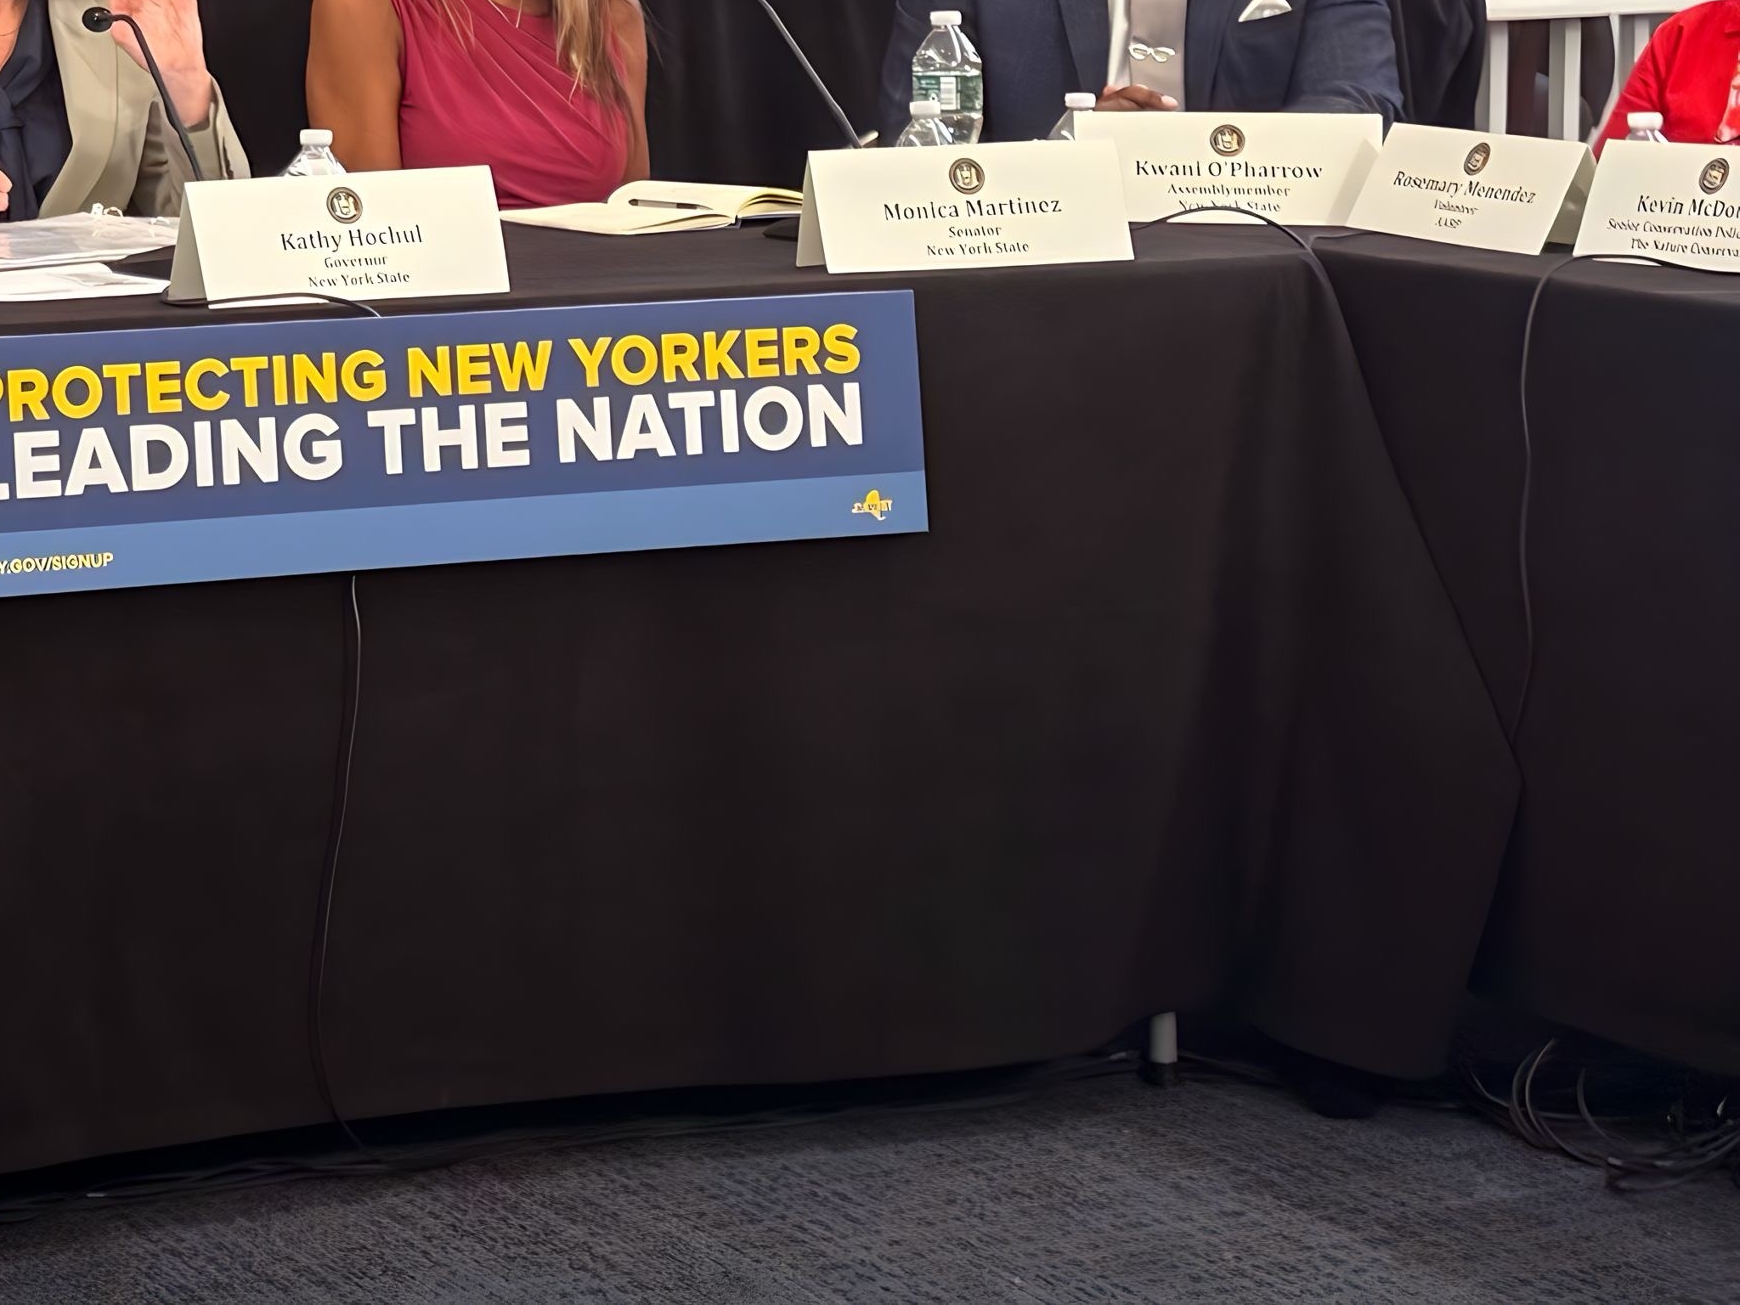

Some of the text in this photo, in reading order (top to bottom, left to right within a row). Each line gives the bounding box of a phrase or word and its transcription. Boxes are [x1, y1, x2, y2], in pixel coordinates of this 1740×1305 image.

[1208, 161, 1323, 179] O'Pharrow
[1393, 171, 1537, 204] Rosemary Menendez
[883, 197, 1063, 221] Monica Martinez
[1637, 195, 1684, 215] Kevin
[281, 224, 424, 253] Kathy Hochul
[927, 244, 956, 257] New
[324, 255, 388, 269] Governor
[308, 271, 411, 288] New York State
[407, 339, 553, 398] NEW
[568, 323, 861, 387] YORKERS
[367, 400, 531, 475] THE
[556, 381, 863, 463] NATION
